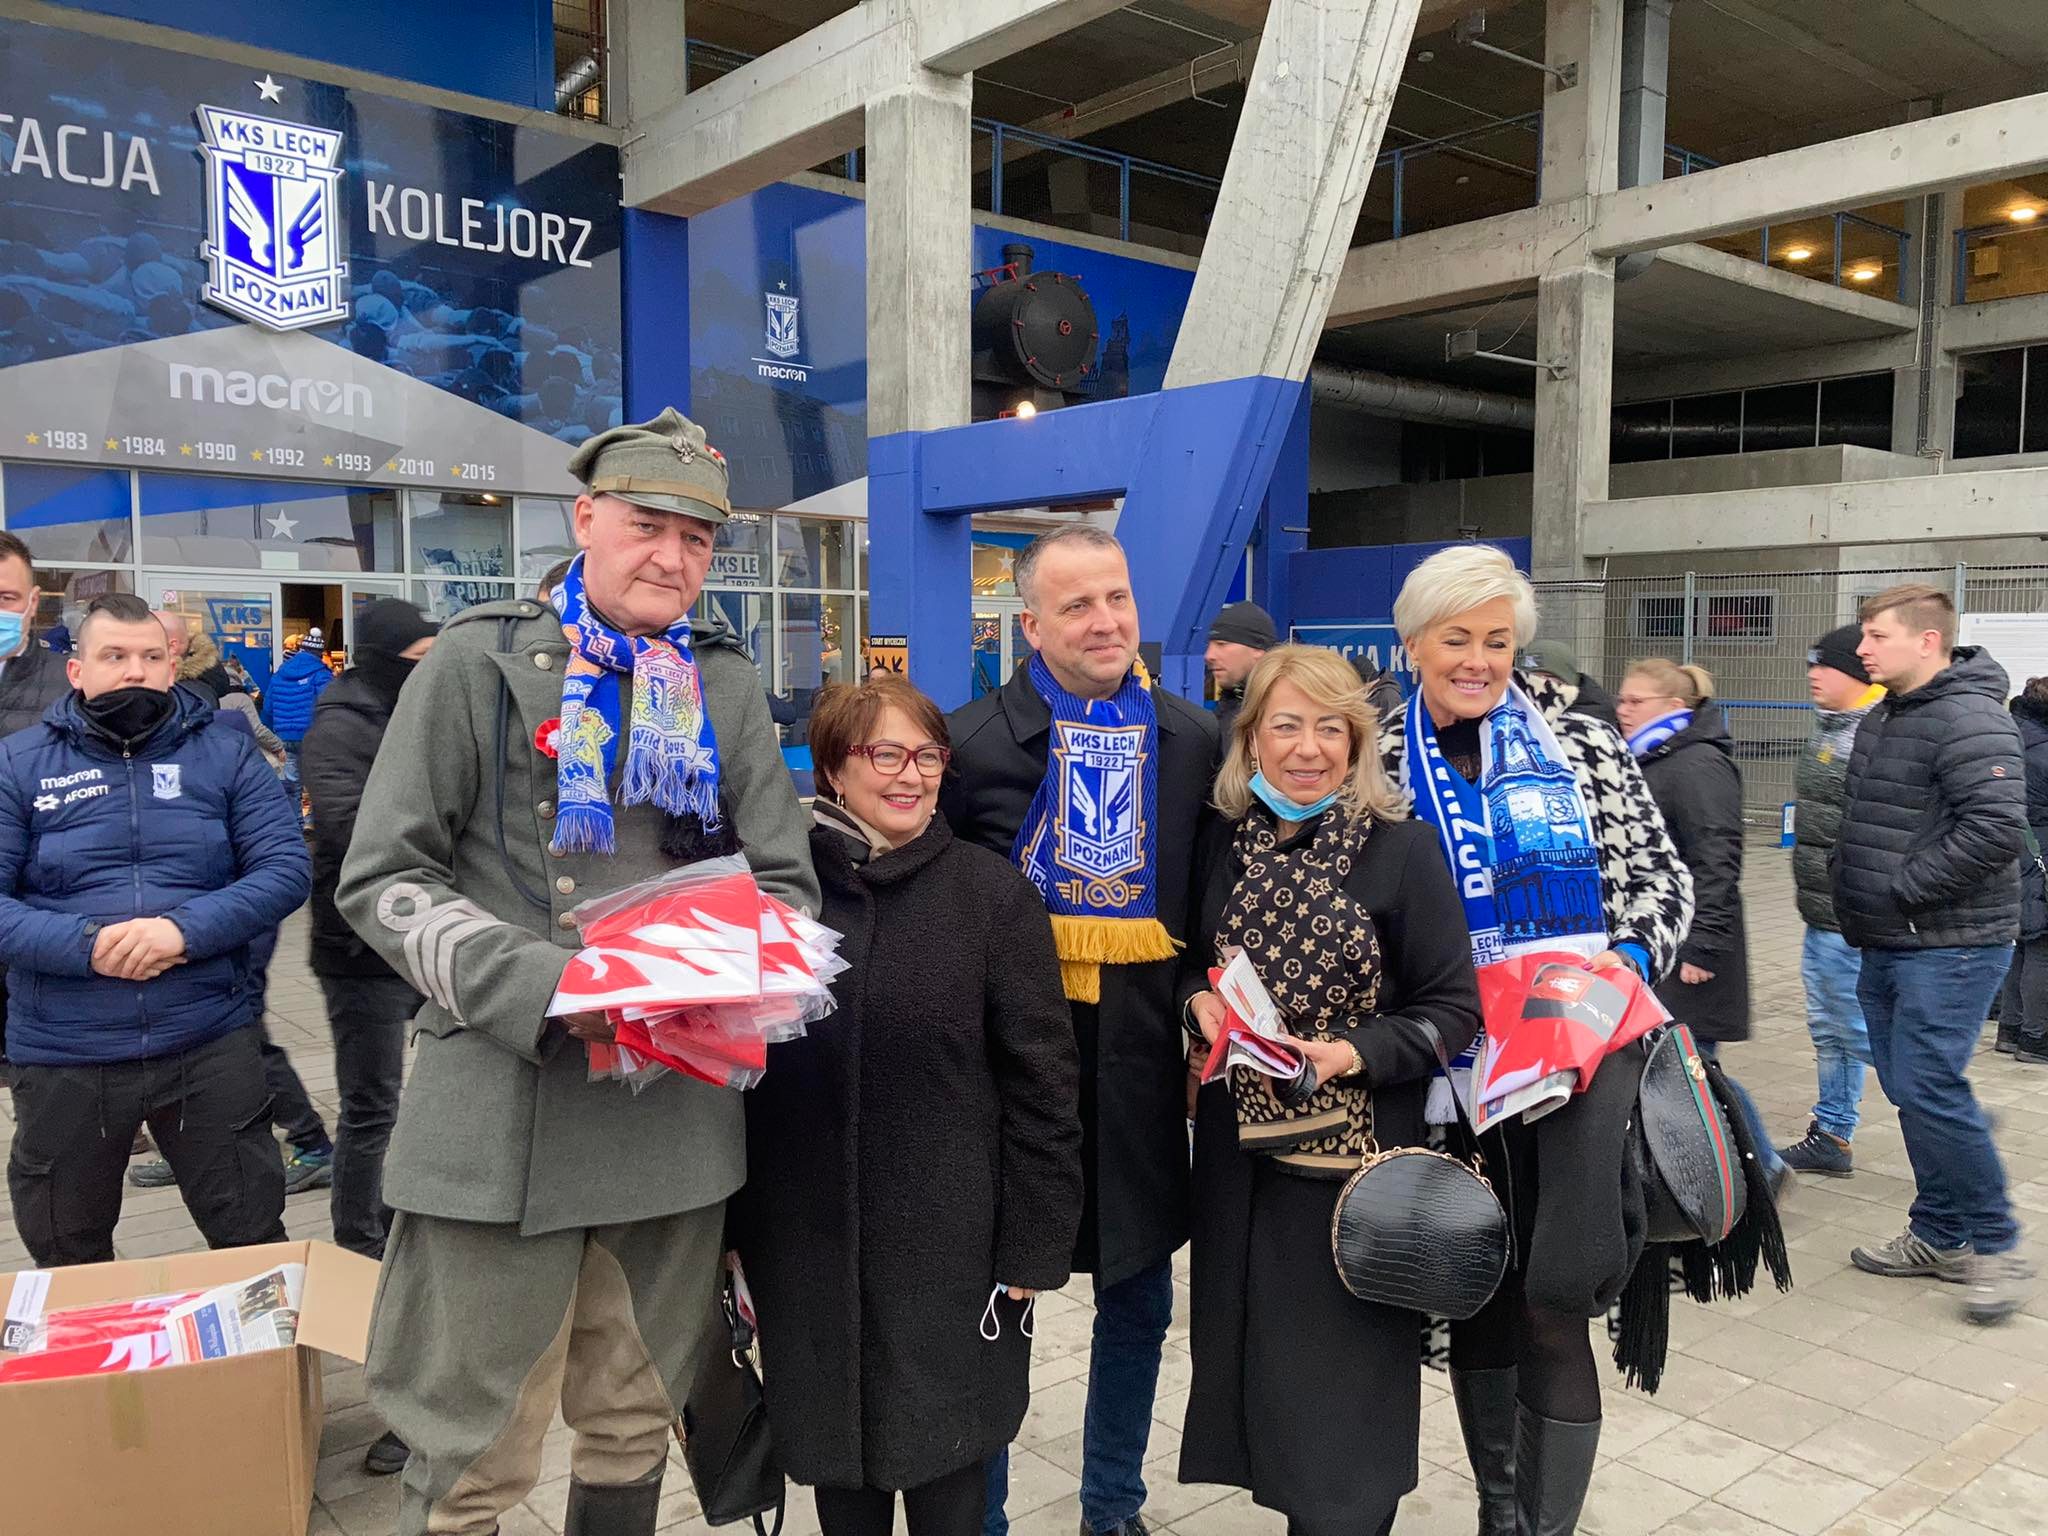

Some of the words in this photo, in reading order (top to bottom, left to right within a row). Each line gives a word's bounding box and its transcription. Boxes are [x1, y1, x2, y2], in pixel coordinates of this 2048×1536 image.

[220, 119, 264, 146] KKS
[273, 129, 327, 158] LECH
[254, 154, 296, 176] 1922
[366, 180, 593, 269] KOLEJORZ
[232, 272, 325, 312] POZNAŃ
[758, 364, 807, 382] macron
[169, 362, 373, 418] macron
[43, 430, 88, 450] 1983
[122, 436, 166, 456] 1984
[195, 441, 236, 461] 1990
[266, 447, 304, 467] 1992
[336, 453, 371, 472] 1993
[399, 458, 434, 476] 2010
[462, 463, 495, 481] 2015
[221, 606, 263, 626] KKS
[632, 729, 661, 751] Wild
[664, 738, 686, 755] Boys
[1071, 731, 1101, 749] KKS
[1103, 735, 1136, 751] LECH
[1090, 754, 1119, 768] 1922
[40, 768, 102, 790] macron
[1073, 840, 1129, 868] POZNAŃ
